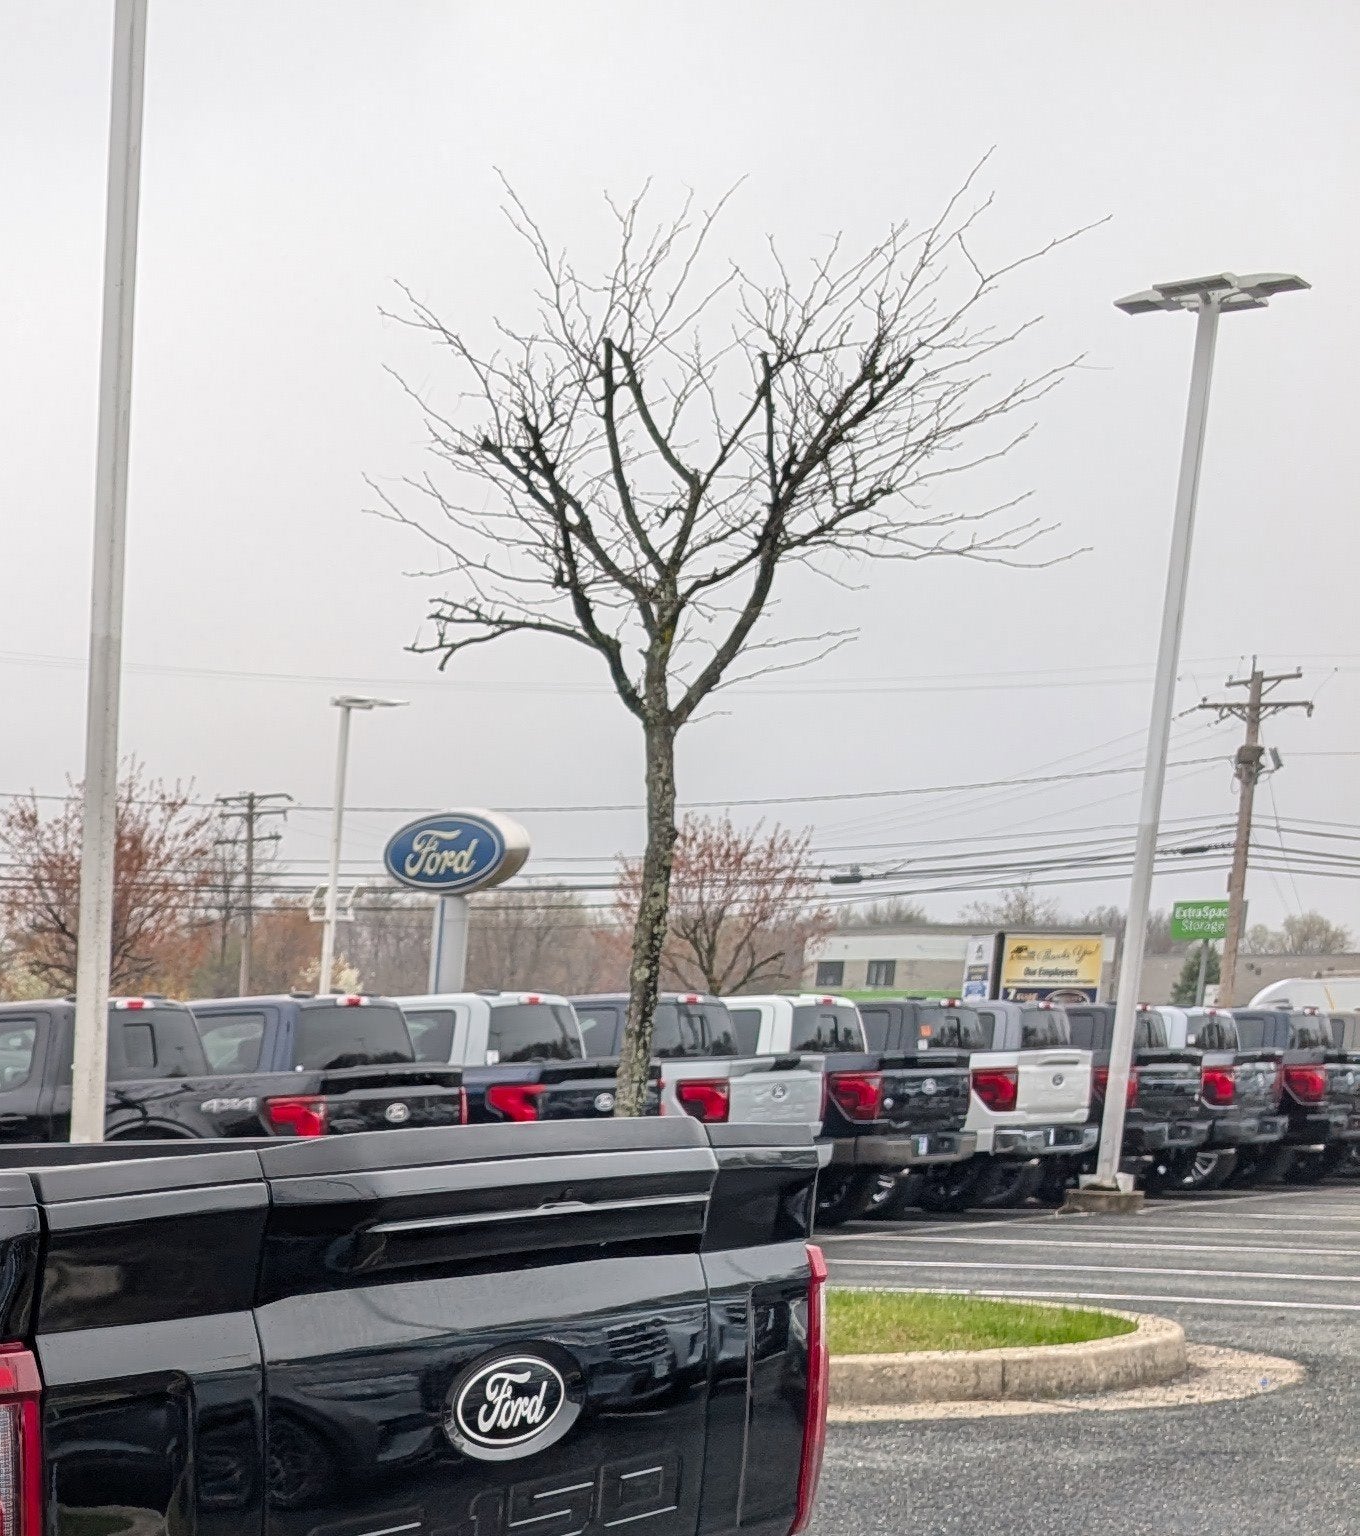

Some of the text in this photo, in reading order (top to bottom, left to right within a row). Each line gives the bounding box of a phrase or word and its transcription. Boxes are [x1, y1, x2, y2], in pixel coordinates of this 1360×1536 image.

[404, 829, 479, 878] Ford
[1175, 905, 1229, 920] ExtraSpac
[1181, 918, 1226, 934] Storage
[477, 1369, 546, 1433] Ford
